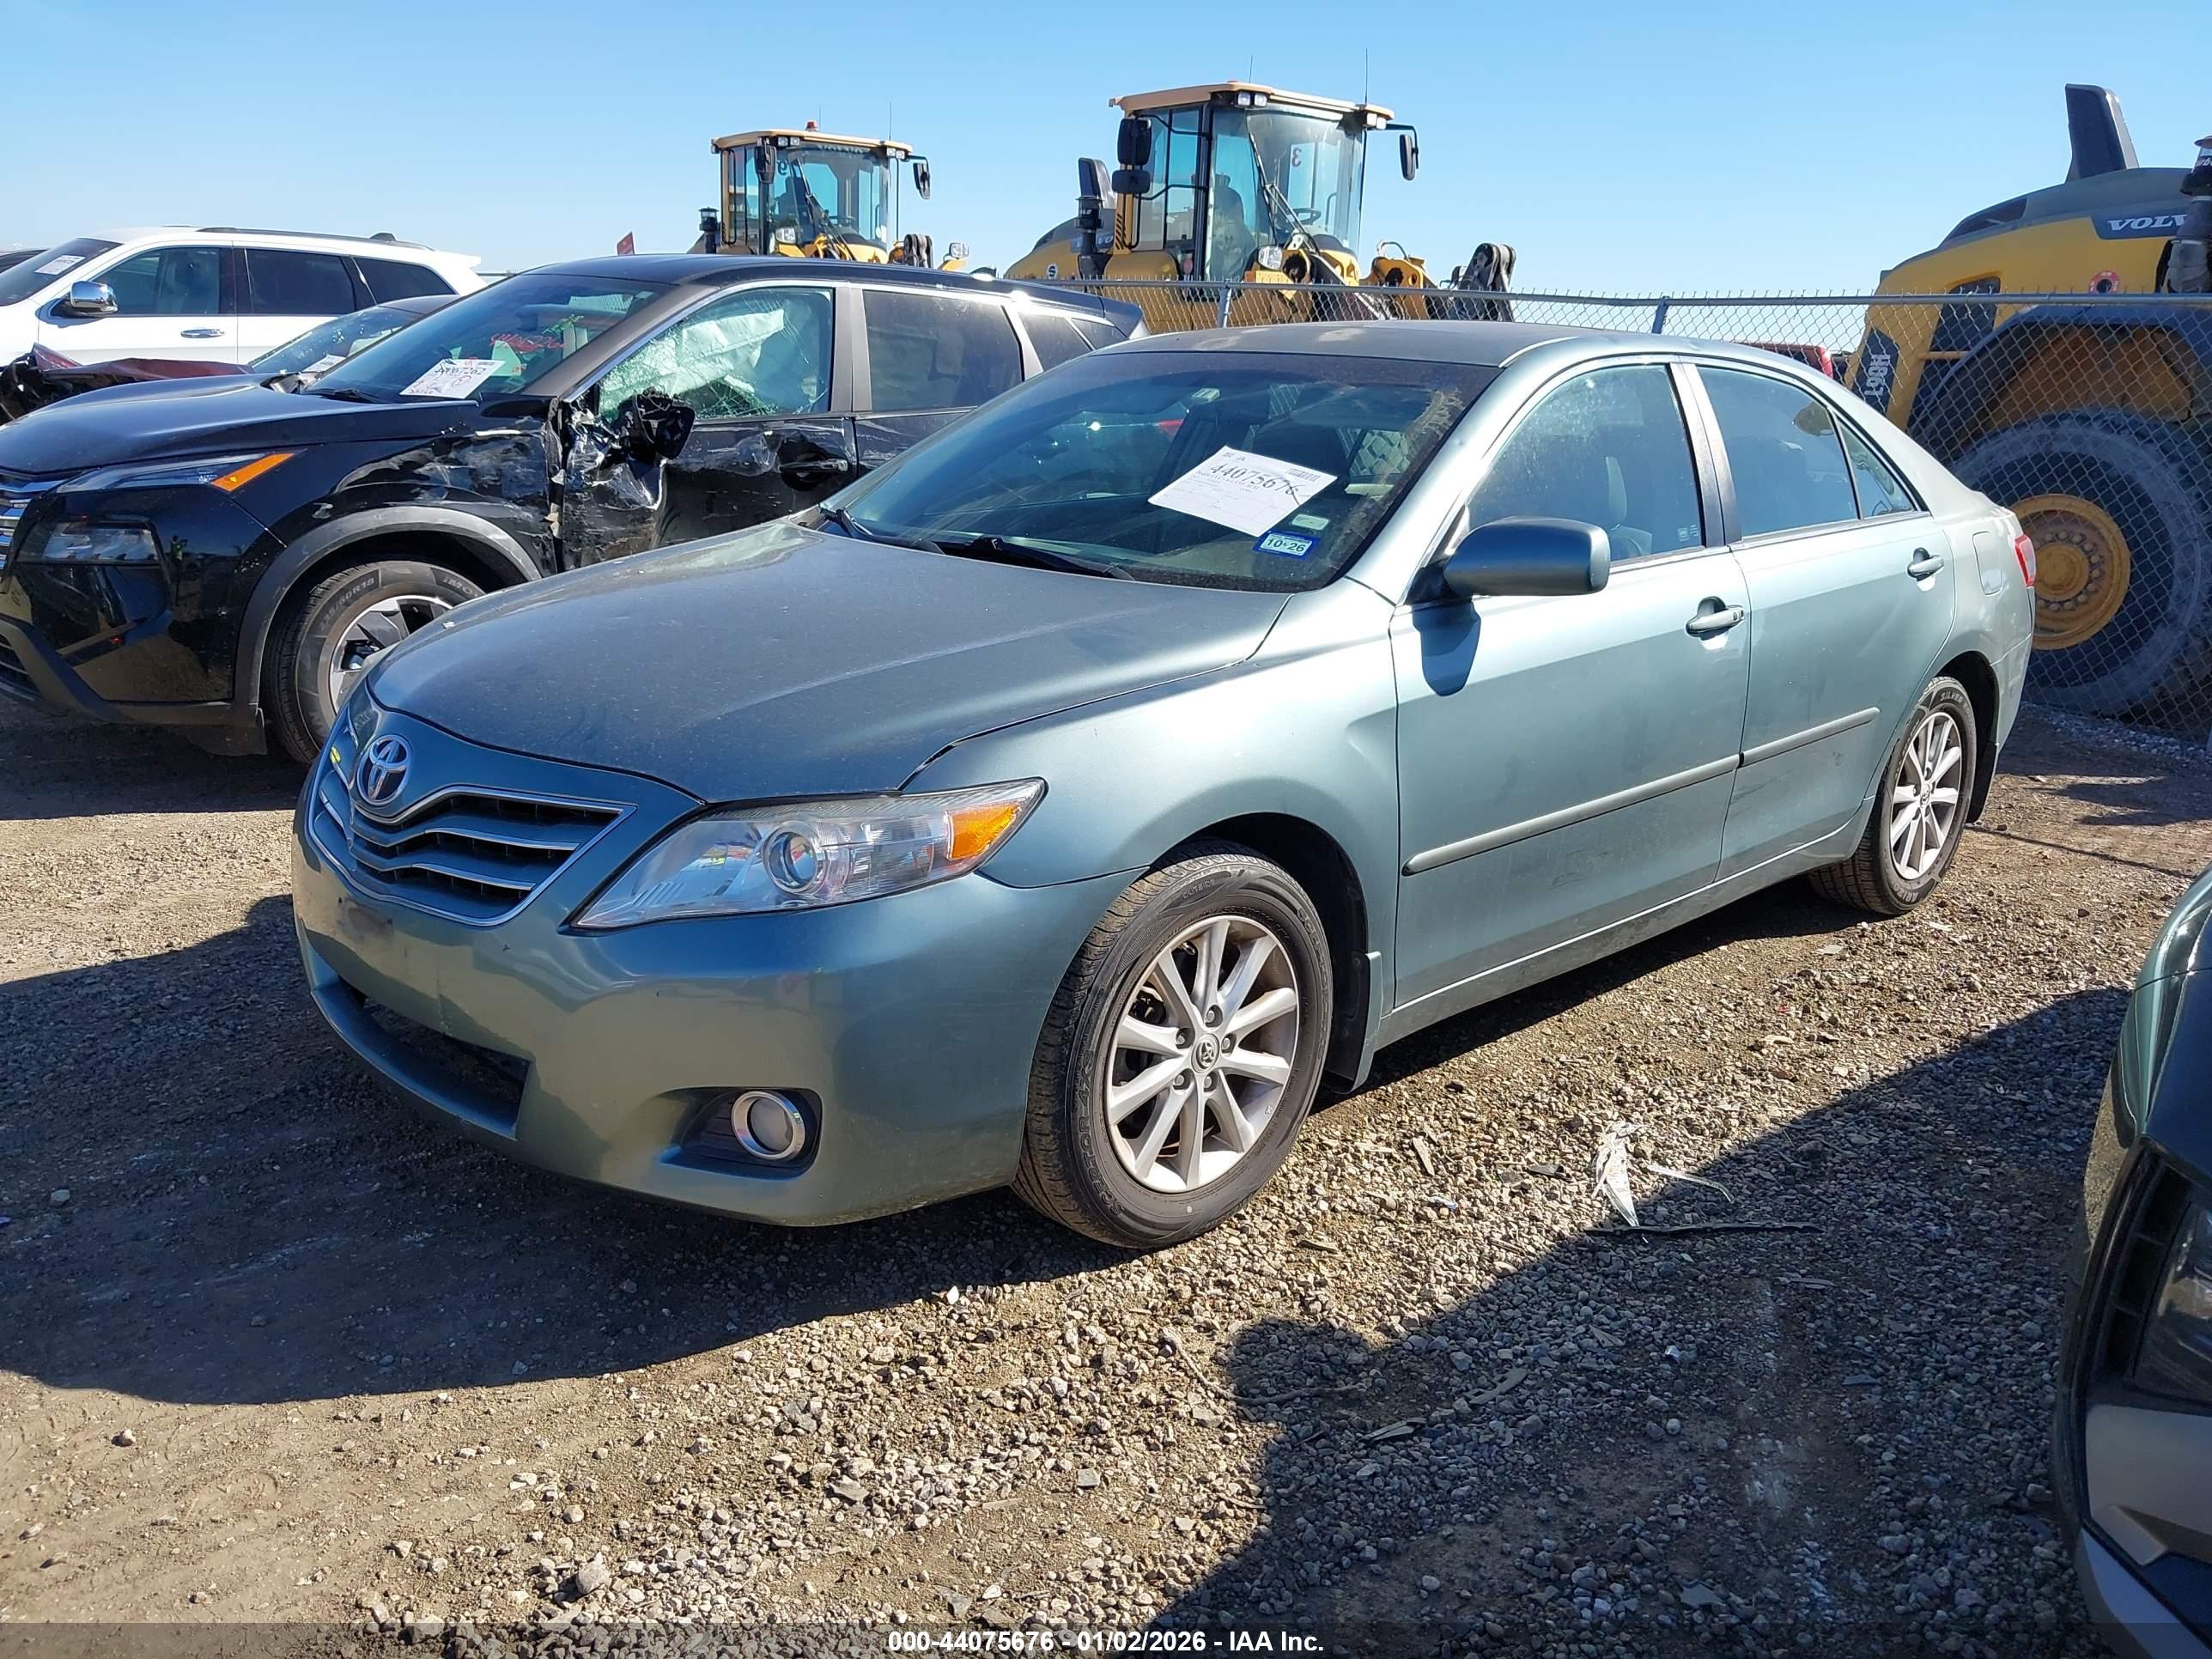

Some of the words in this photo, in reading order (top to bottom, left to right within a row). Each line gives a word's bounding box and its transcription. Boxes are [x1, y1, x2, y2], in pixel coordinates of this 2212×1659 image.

[2107, 214, 2189, 231] VOLV
[1210, 463, 1305, 495] 44075676
[1939, 690, 1964, 704] SILVER
[1079, 1115, 1125, 1216] SCEPTOR
